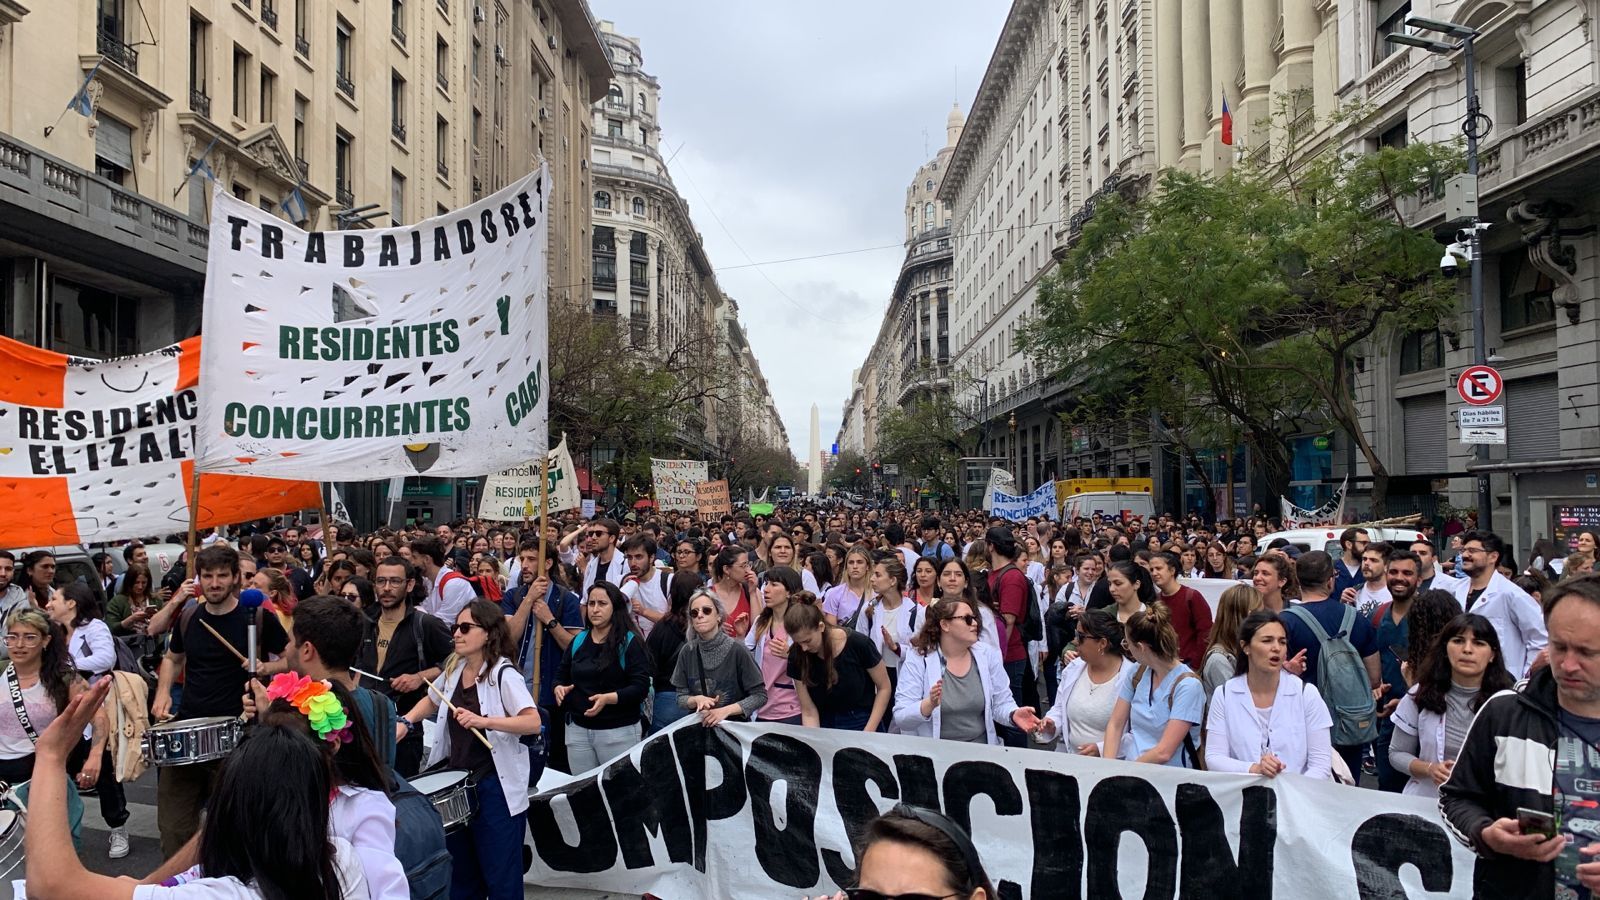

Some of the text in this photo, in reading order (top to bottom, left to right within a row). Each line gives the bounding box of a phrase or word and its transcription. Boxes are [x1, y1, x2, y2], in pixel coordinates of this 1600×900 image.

[279, 294, 511, 362] RESIDENTES Y
[18, 389, 198, 441] RESIDENC
[223, 396, 471, 441] CONCURRENTES
[495, 484, 542, 498] RESIDENTE
[994, 483, 1054, 503] RESIDENTE
[9, 679, 23, 703] LOVE
[16, 705, 31, 729] LOVE
[522, 722, 1277, 900] OMPOSCION
